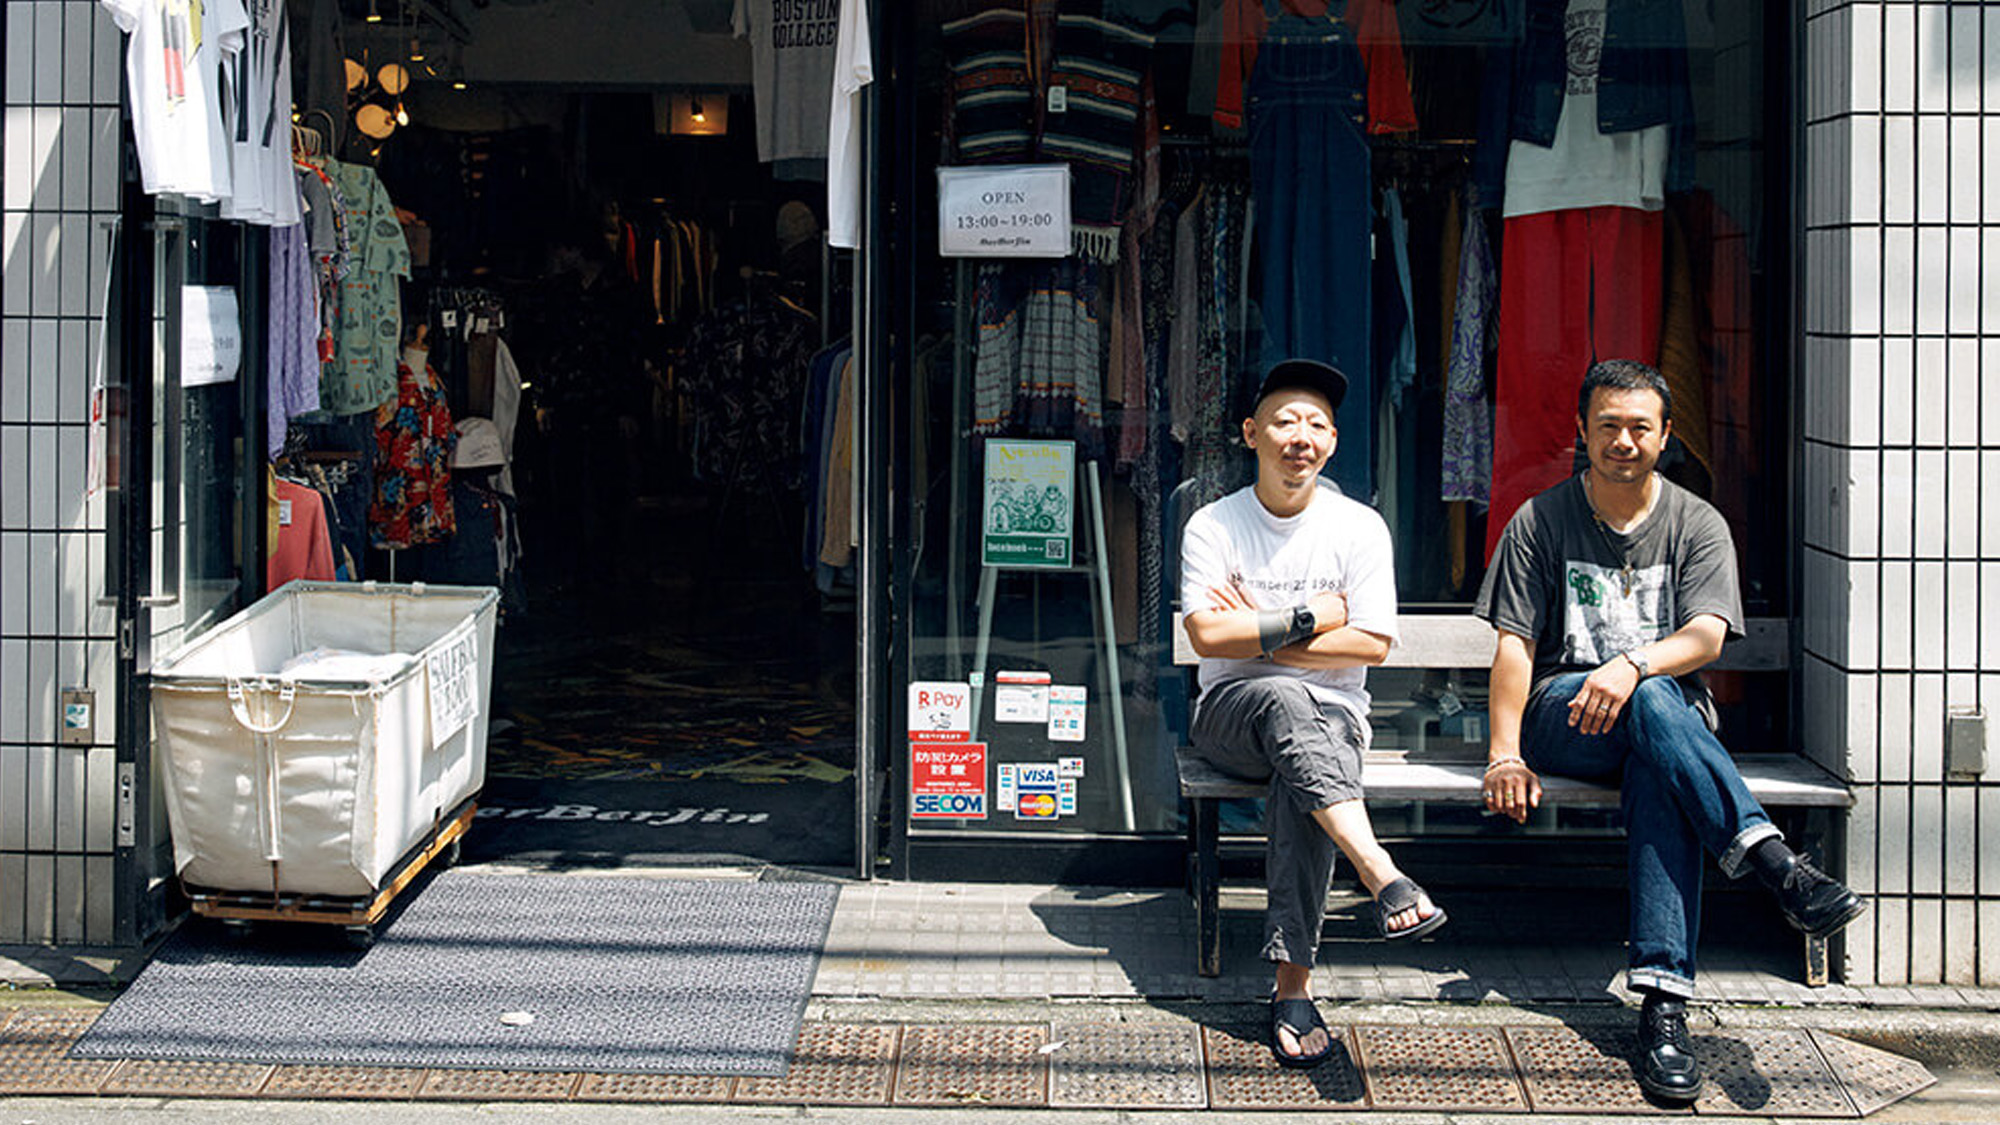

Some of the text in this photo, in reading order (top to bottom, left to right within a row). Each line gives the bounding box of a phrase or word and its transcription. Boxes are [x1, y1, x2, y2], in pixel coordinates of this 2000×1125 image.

[772, 21, 837, 48] COLLEGE
[981, 192, 1026, 204] OPEN
[934, 690, 964, 710] Pay
[1021, 769, 1055, 782] VISA
[915, 794, 983, 812] SECOM
[475, 804, 770, 825] erBerJin
